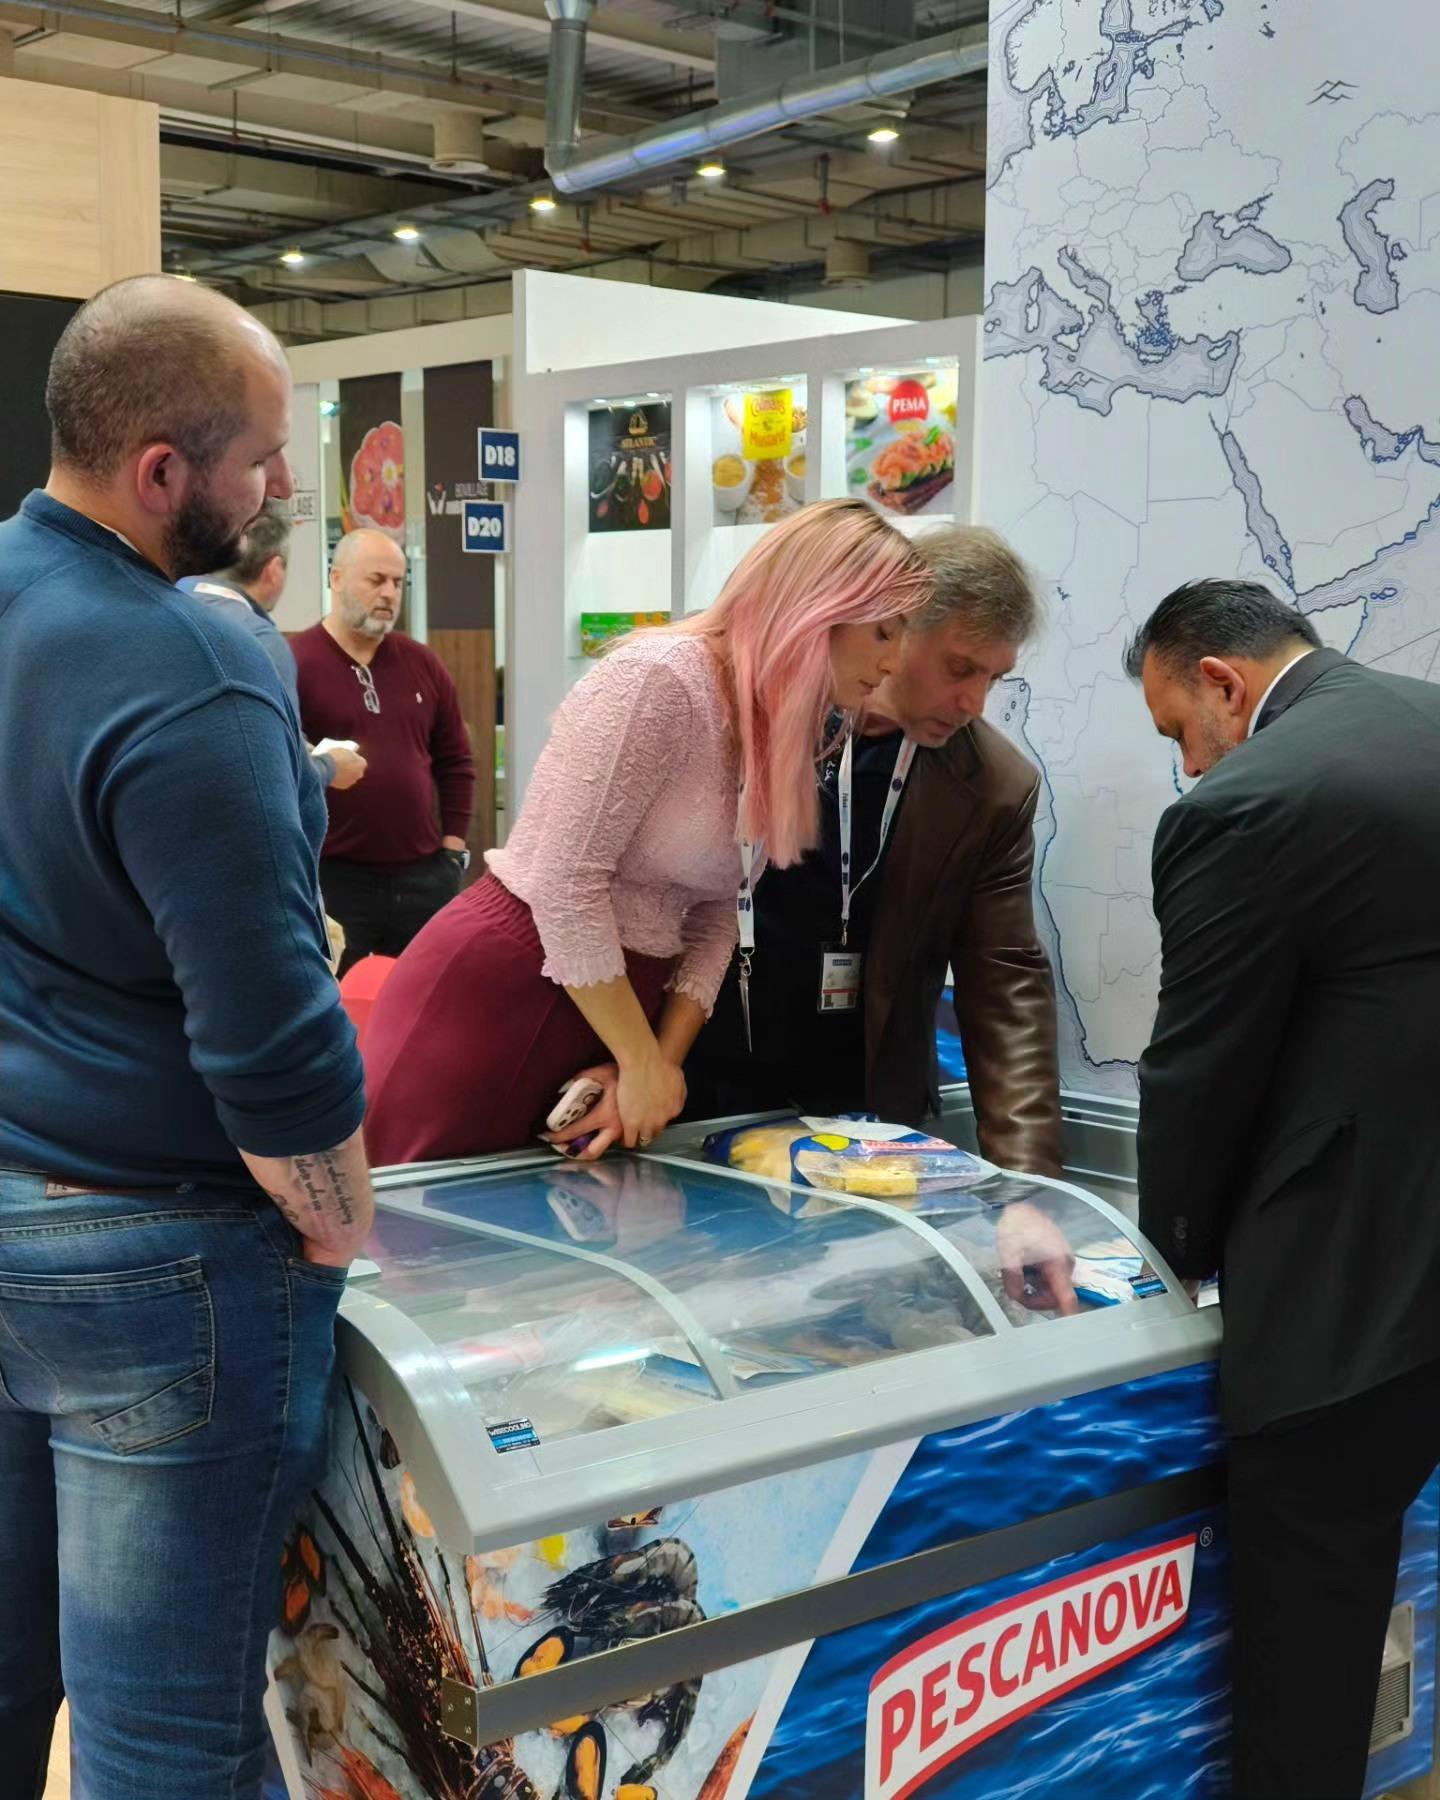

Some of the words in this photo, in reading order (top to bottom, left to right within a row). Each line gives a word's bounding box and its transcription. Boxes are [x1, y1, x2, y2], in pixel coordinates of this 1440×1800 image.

[891, 398, 927, 413] PEMA
[484, 445, 516, 467] D18
[467, 516, 502, 538] D20
[880, 1559, 1184, 1786] PESCANOVA
